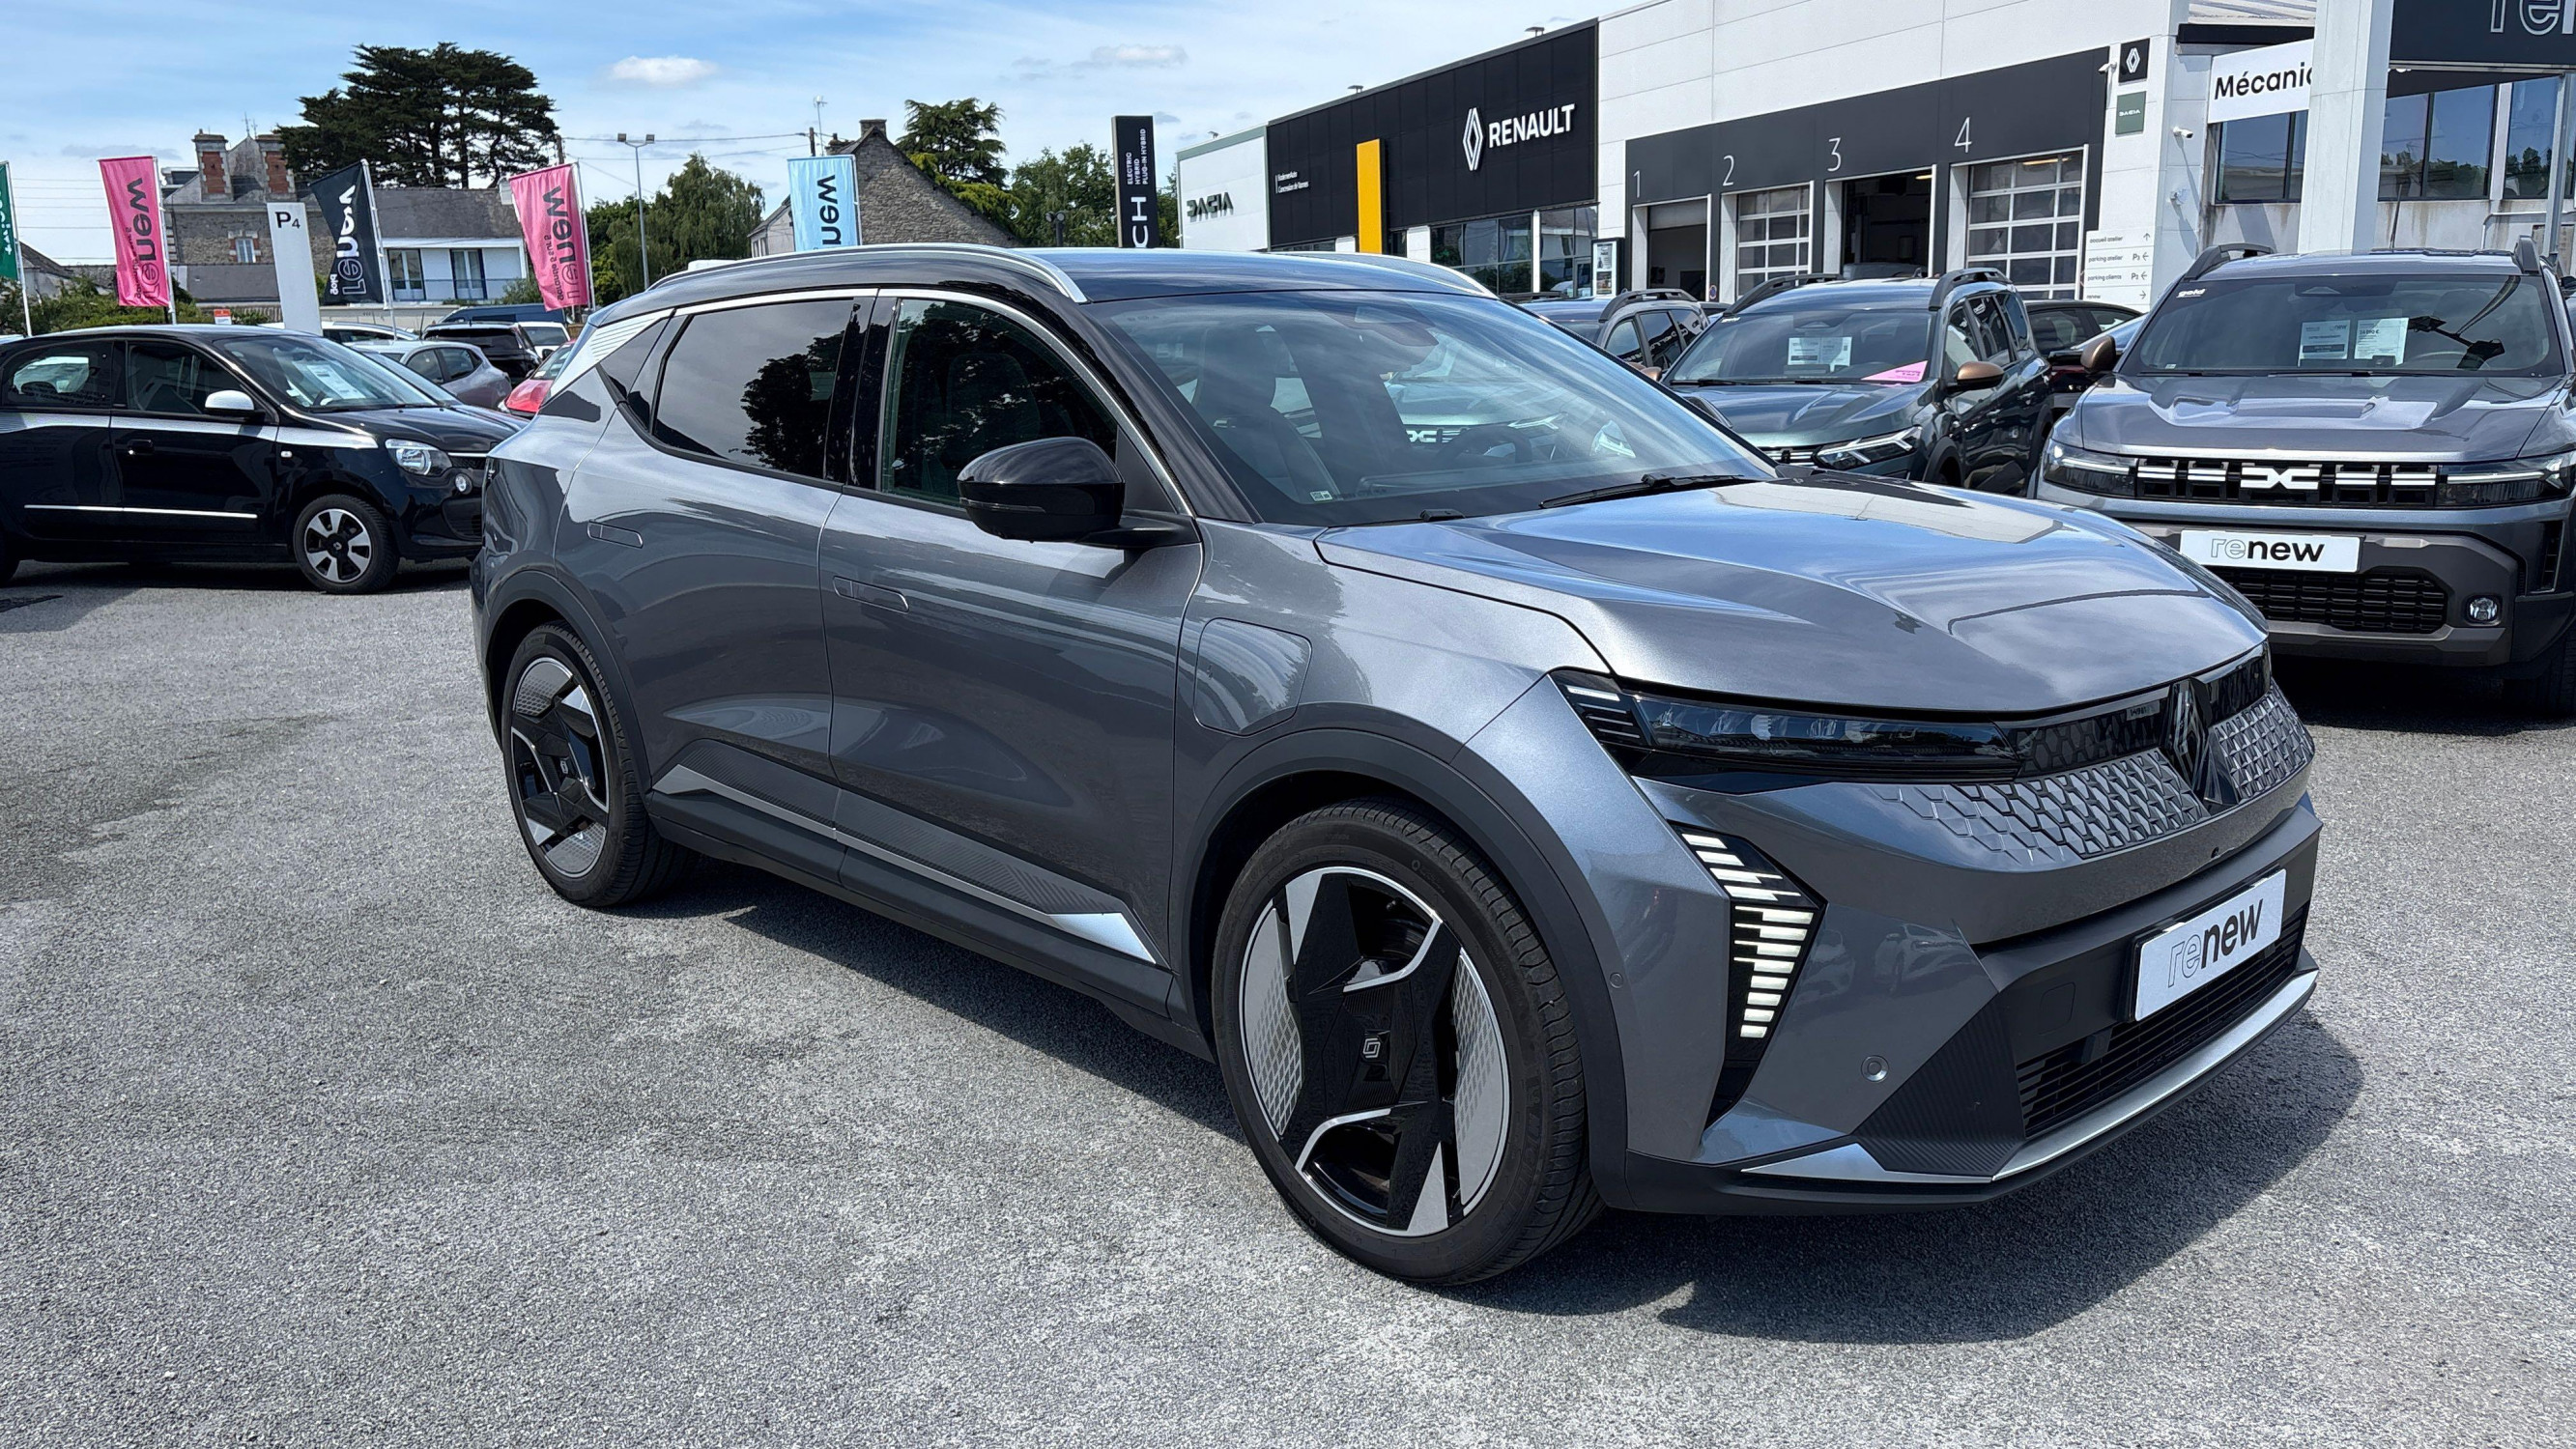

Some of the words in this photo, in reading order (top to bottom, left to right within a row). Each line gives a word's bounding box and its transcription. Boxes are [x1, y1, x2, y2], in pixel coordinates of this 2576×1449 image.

[1489, 103, 1575, 148] RENAULT
[1954, 117, 1972, 154] 4
[1723, 155, 1734, 186] 2
[1827, 137, 1842, 172] 3
[1633, 170, 1641, 198] 1
[1131, 196, 1149, 248] CH
[2211, 538, 2325, 562] renew
[2168, 898, 2264, 988] renew
